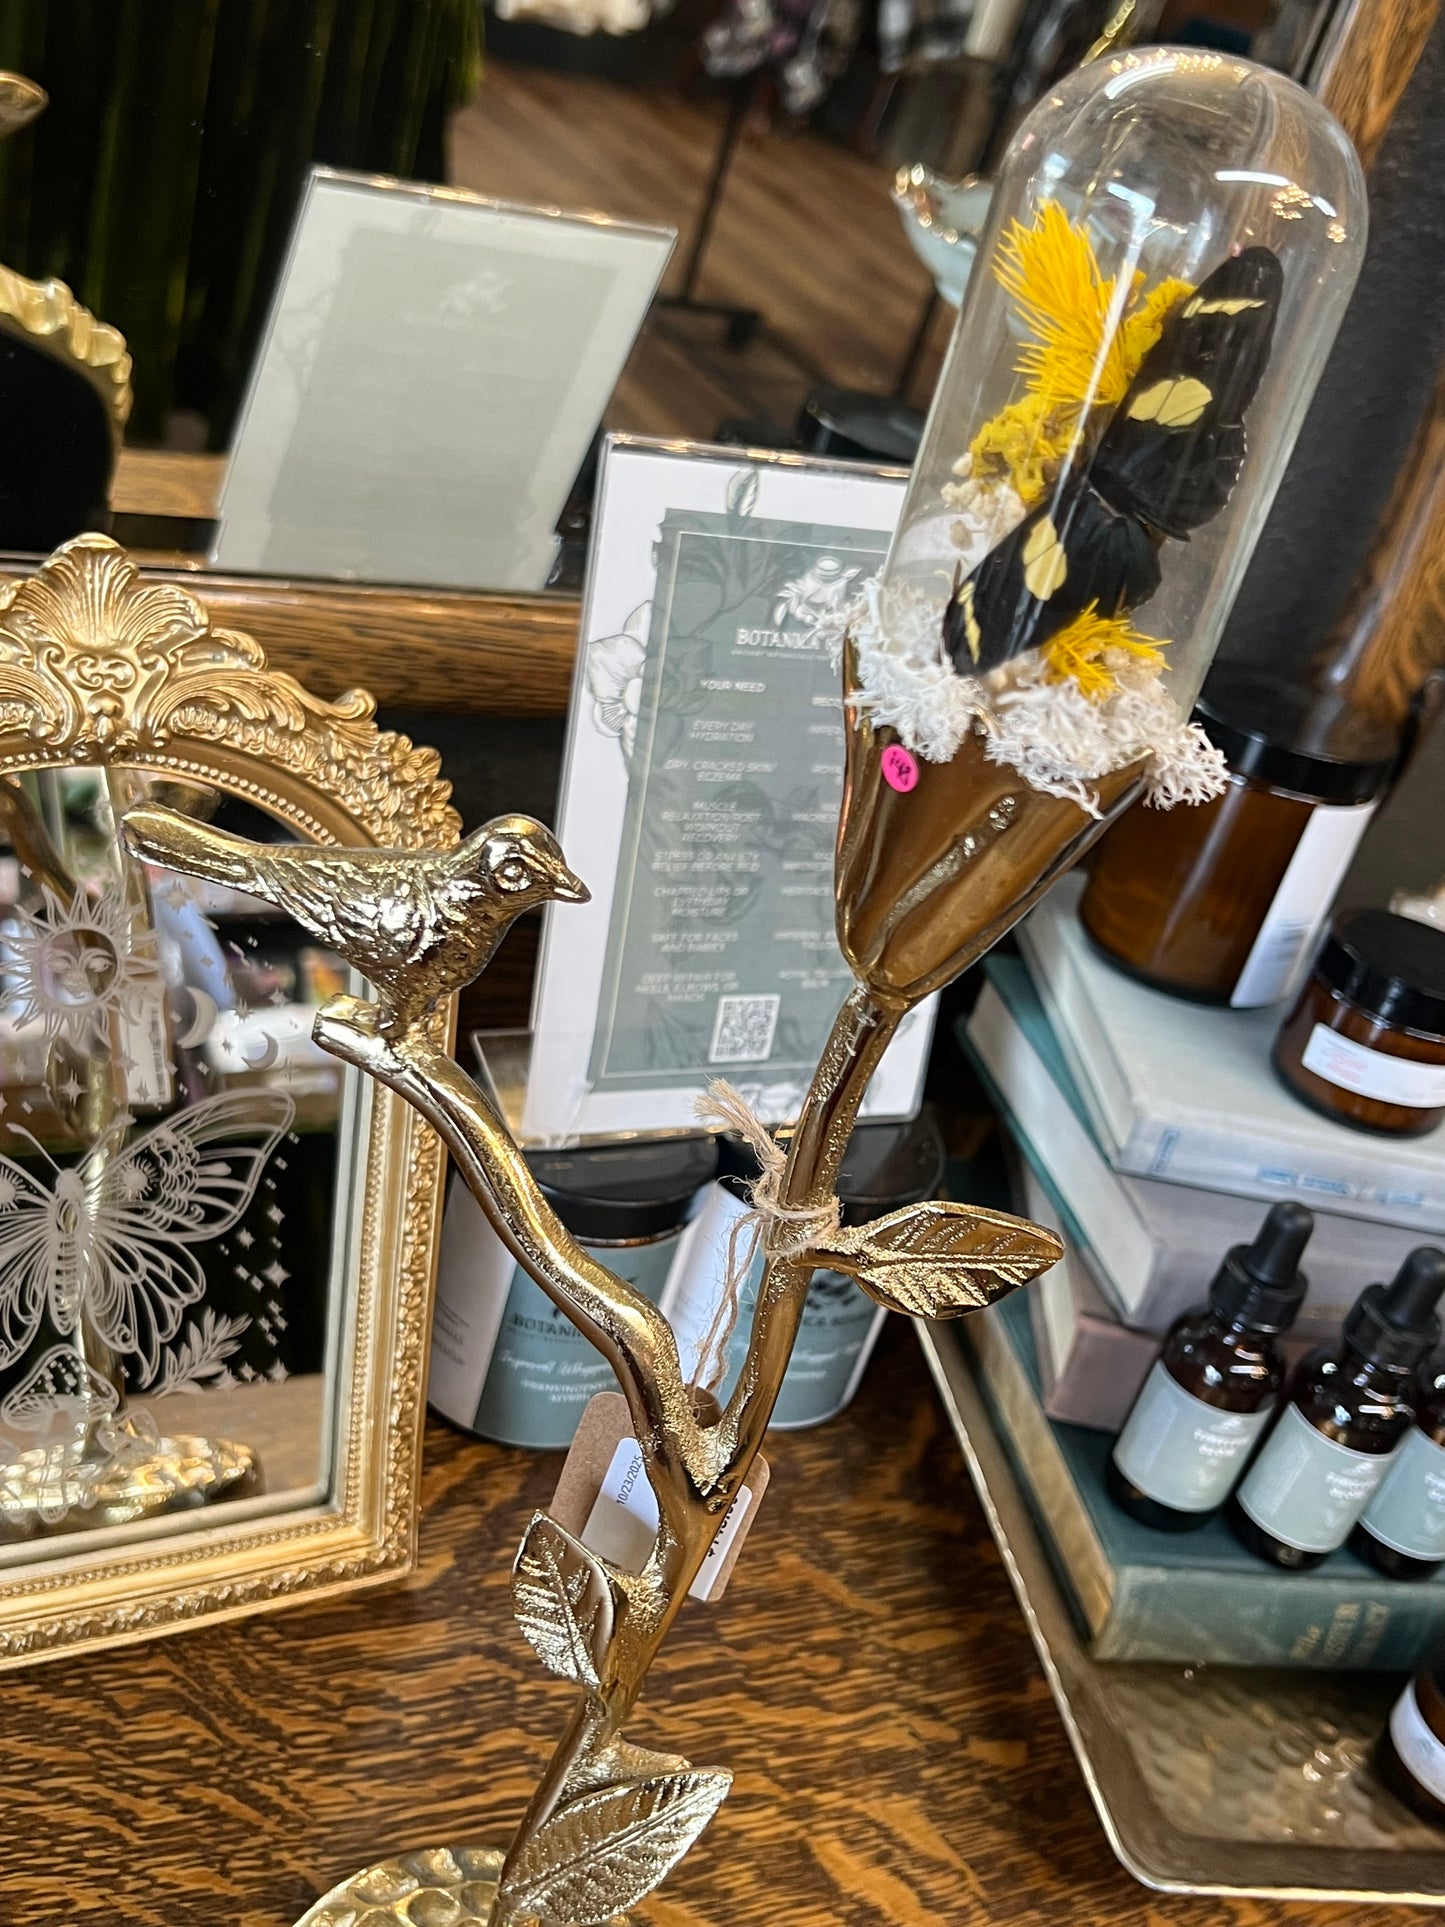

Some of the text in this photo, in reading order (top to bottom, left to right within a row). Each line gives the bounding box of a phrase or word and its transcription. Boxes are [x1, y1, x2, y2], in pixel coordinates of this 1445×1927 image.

[701, 679, 767, 693] YOUR NEED
[692, 720, 729, 732] EVERY
[689, 731, 755, 743] HYDRATION
[693, 761, 745, 772] CRACKED
[697, 772, 743, 782] ECZEMA
[693, 801, 737, 812] MUSCLE
[683, 822, 741, 833] WORKOUT
[682, 832, 740, 844] RECOVERY
[616, 1455, 644, 1505] 10/23/2025
